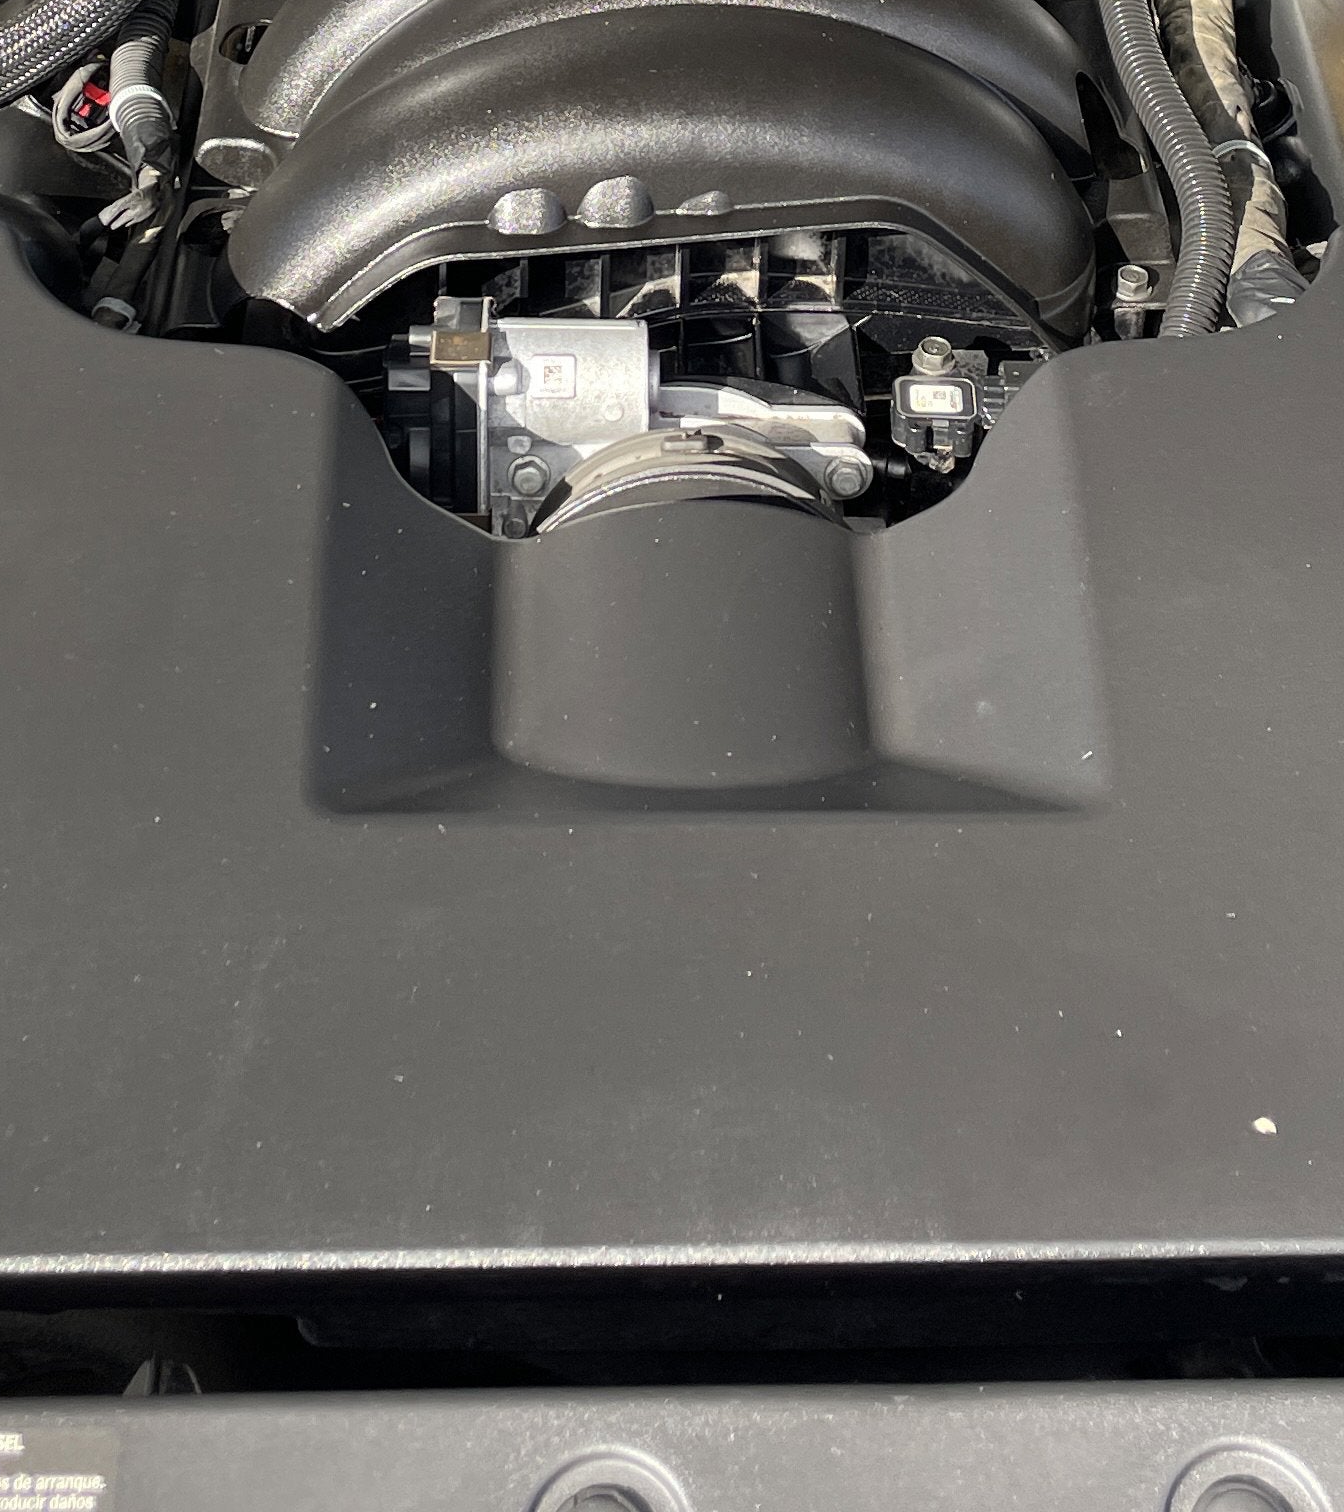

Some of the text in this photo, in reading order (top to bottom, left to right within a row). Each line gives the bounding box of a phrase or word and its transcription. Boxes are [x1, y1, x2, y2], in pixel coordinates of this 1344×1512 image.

[12, 1473, 32, 1491] de
[35, 1474, 106, 1494] arranque.
[49, 1494, 95, 1510] daños
